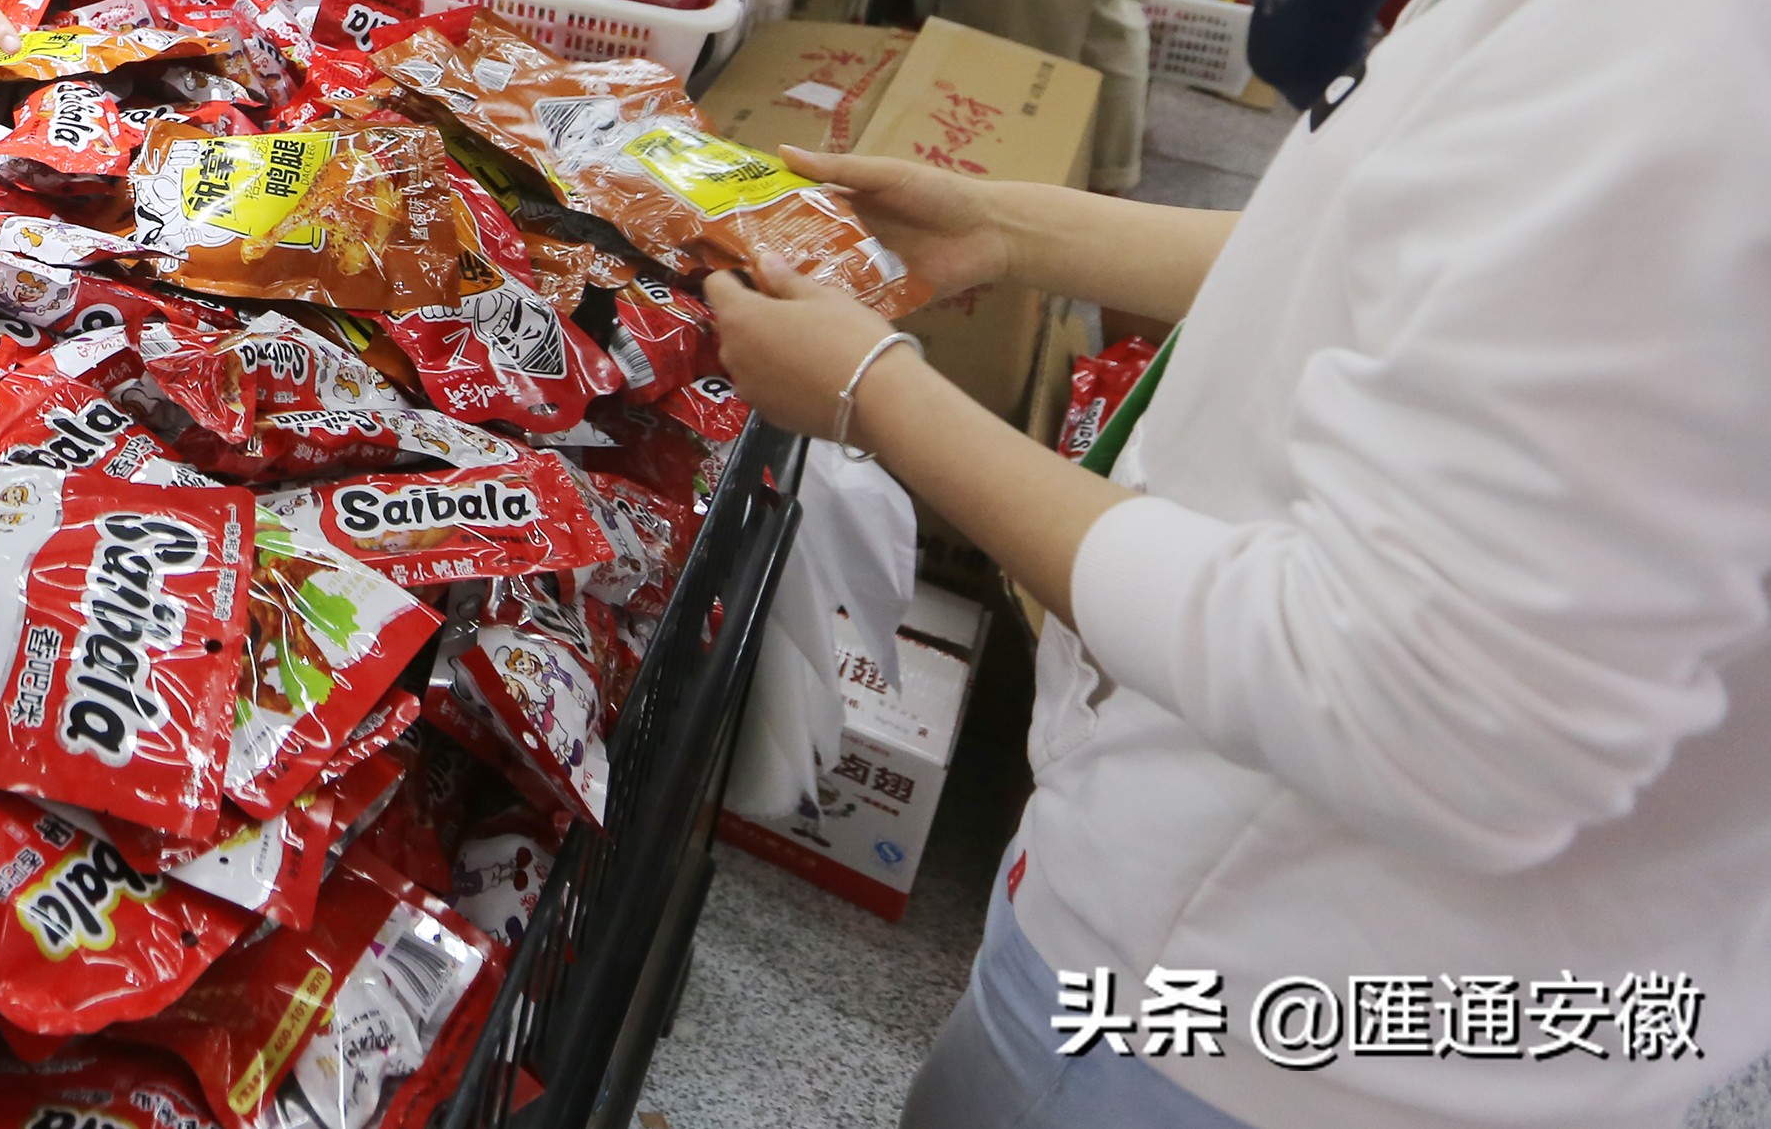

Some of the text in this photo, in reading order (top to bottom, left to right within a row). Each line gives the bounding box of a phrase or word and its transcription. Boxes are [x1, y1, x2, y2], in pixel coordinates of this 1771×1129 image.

[54, 84, 101, 146] Saibala
[264, 139, 306, 198] 鸭腿
[105, 434, 163, 478] 香吧咪
[340, 483, 533, 531] Saibala
[214, 504, 241, 620] 一脉相承 再续传奇
[66, 514, 199, 753] Saibala
[11, 628, 60, 726] 香吧咪
